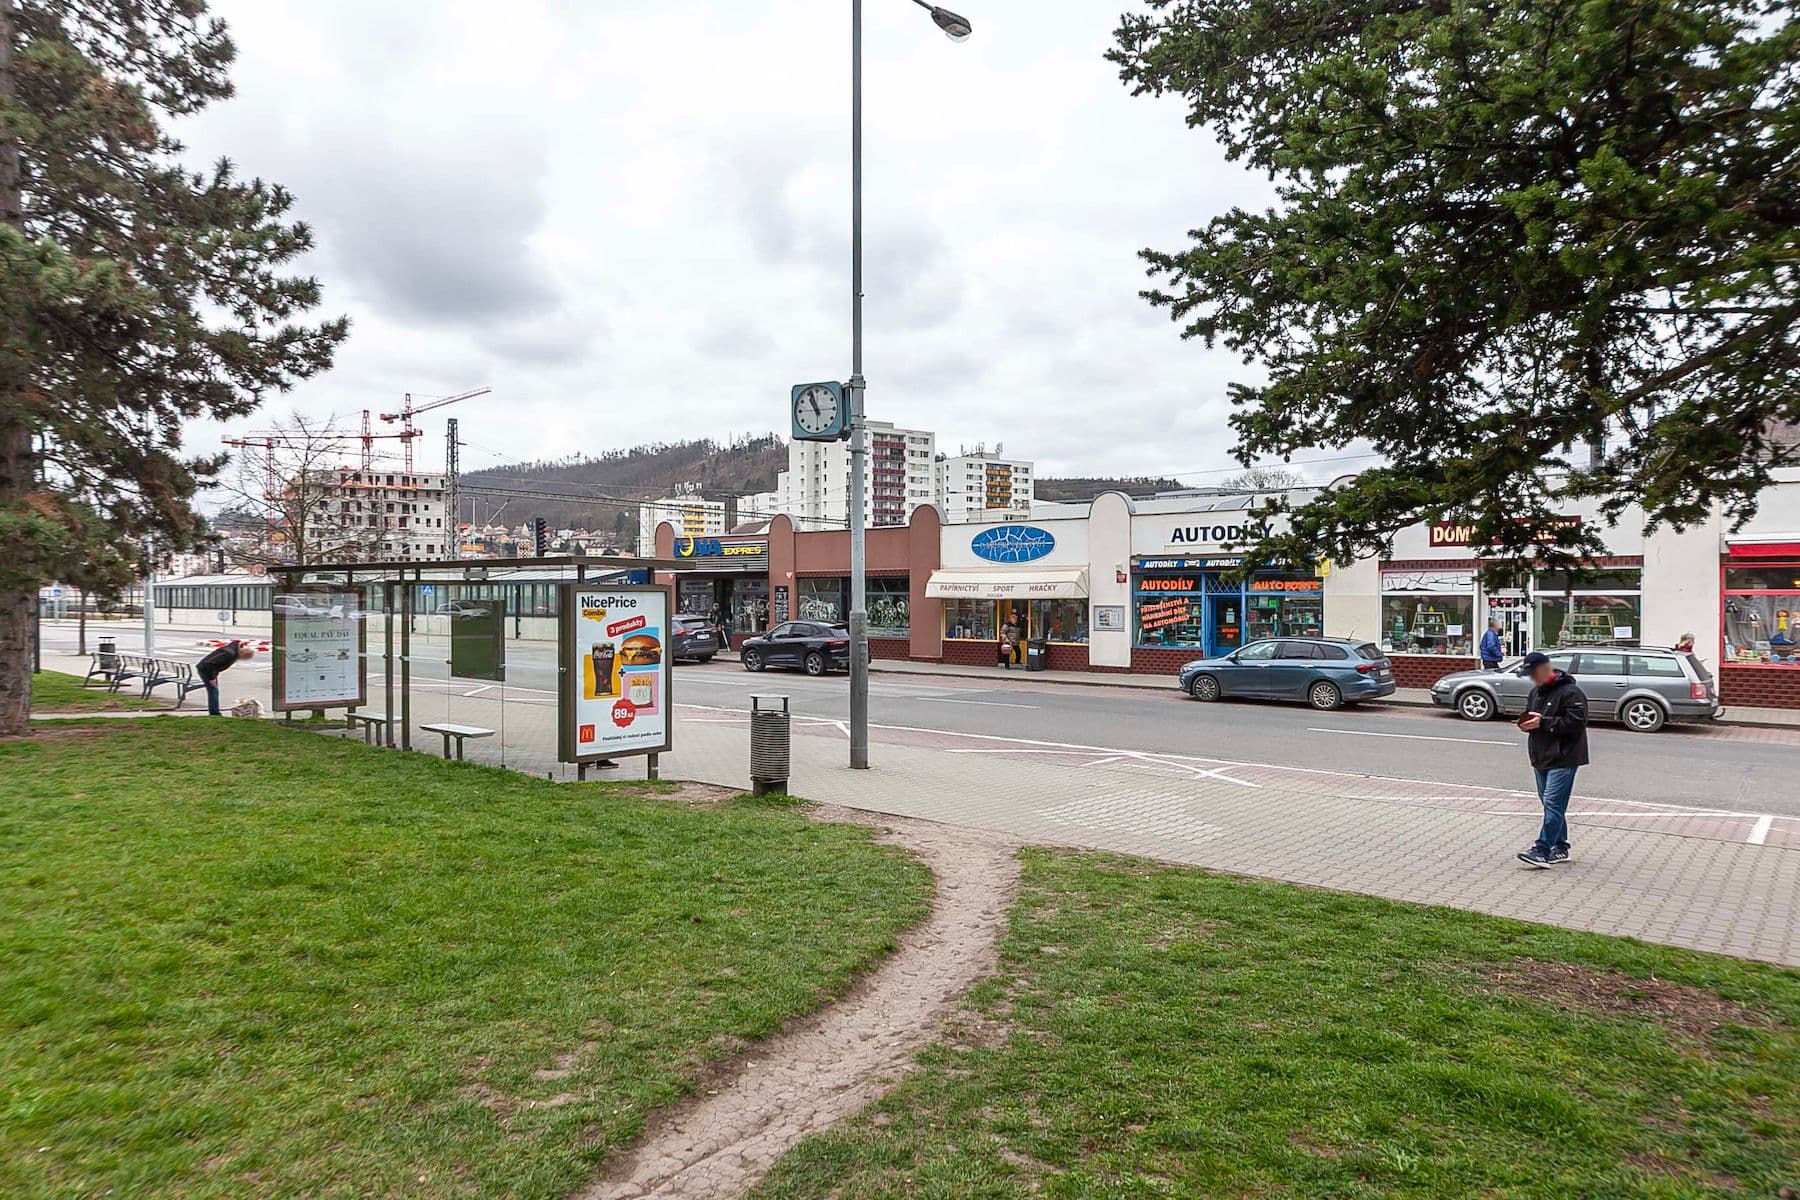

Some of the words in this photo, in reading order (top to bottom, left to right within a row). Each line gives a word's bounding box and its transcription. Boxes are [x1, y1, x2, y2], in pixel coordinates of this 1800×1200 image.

[723, 546, 761, 555] EXPRES
[1144, 559, 1178, 568] AUTODÍLY
[1206, 558, 1241, 567] AUTODÍLY
[939, 584, 979, 592] PAPÍRNICTVÍ
[1029, 583, 1057, 592] HRAČKY
[1140, 577, 1194, 590] AUTODÍLY
[581, 595, 637, 608] NicePrice
[583, 609, 606, 617] Combo
[294, 631, 319, 640] EQUAL
[614, 708, 627, 719] 89
